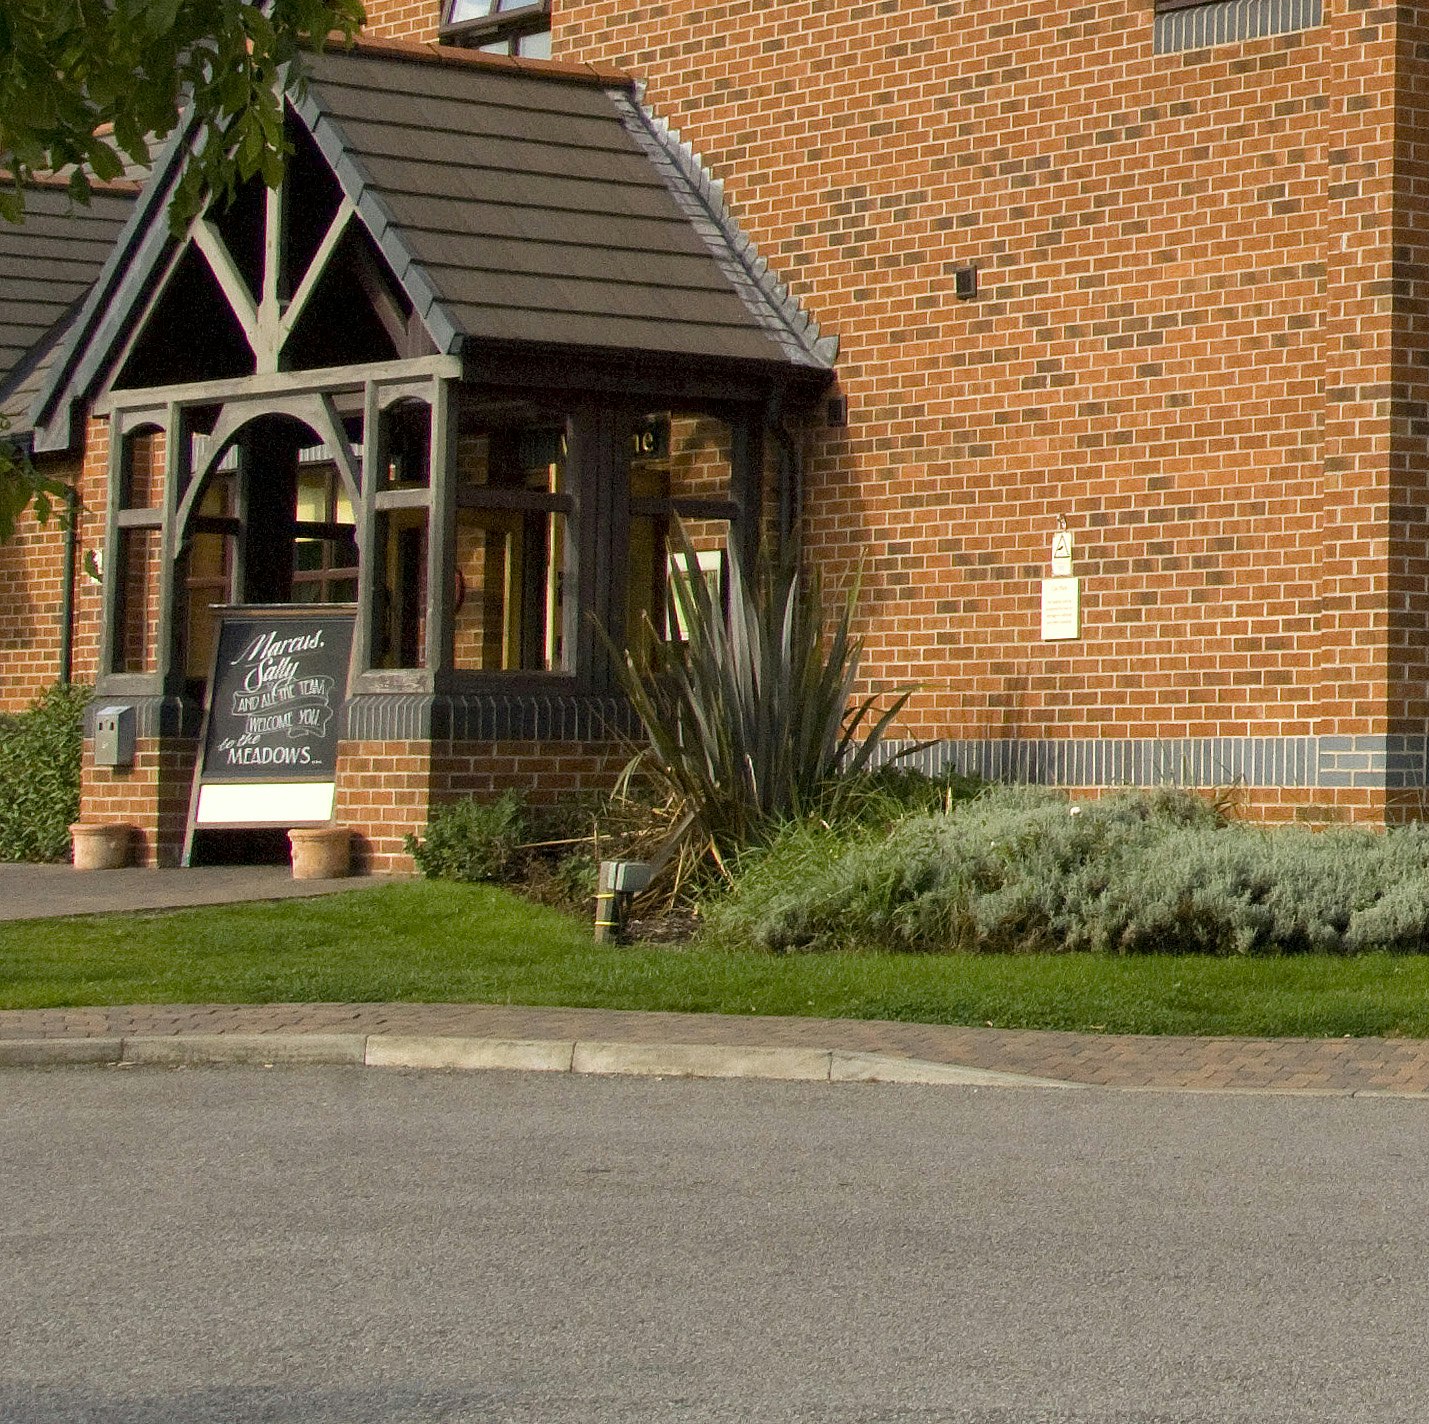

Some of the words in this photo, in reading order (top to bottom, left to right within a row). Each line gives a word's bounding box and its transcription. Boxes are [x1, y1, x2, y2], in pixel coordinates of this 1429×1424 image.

[244, 657, 300, 693] Sally
[238, 695, 260, 712] AND
[277, 684, 295, 701] THE
[299, 678, 326, 695] TEAM
[249, 711, 294, 732] WELCOME
[218, 737, 235, 752] to
[236, 732, 261, 747] the
